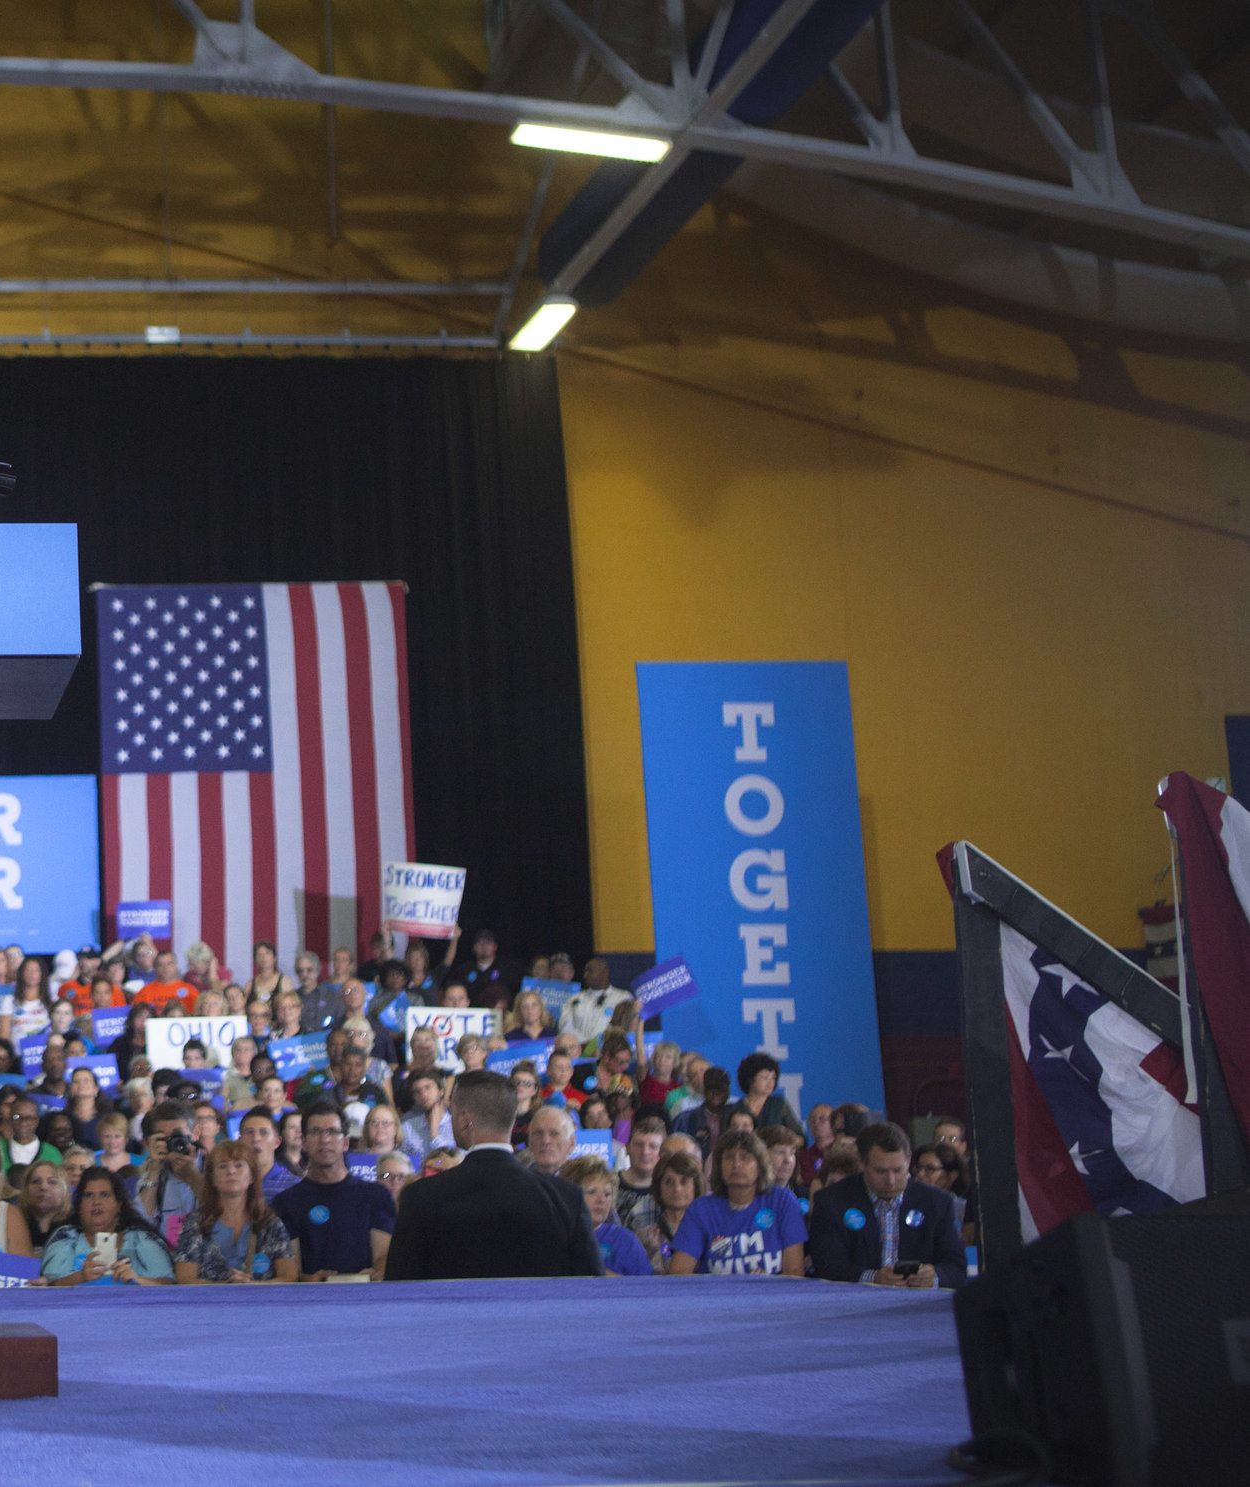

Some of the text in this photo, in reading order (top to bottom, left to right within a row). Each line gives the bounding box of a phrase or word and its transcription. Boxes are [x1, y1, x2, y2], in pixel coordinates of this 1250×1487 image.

[384, 866, 464, 890] STRONGER
[385, 896, 458, 922] TOGETHER
[168, 1022, 234, 1047] OHIO
[294, 1043, 328, 1056] Clinto
[724, 1230, 765, 1257] I'M
[708, 1250, 783, 1275] WITH
